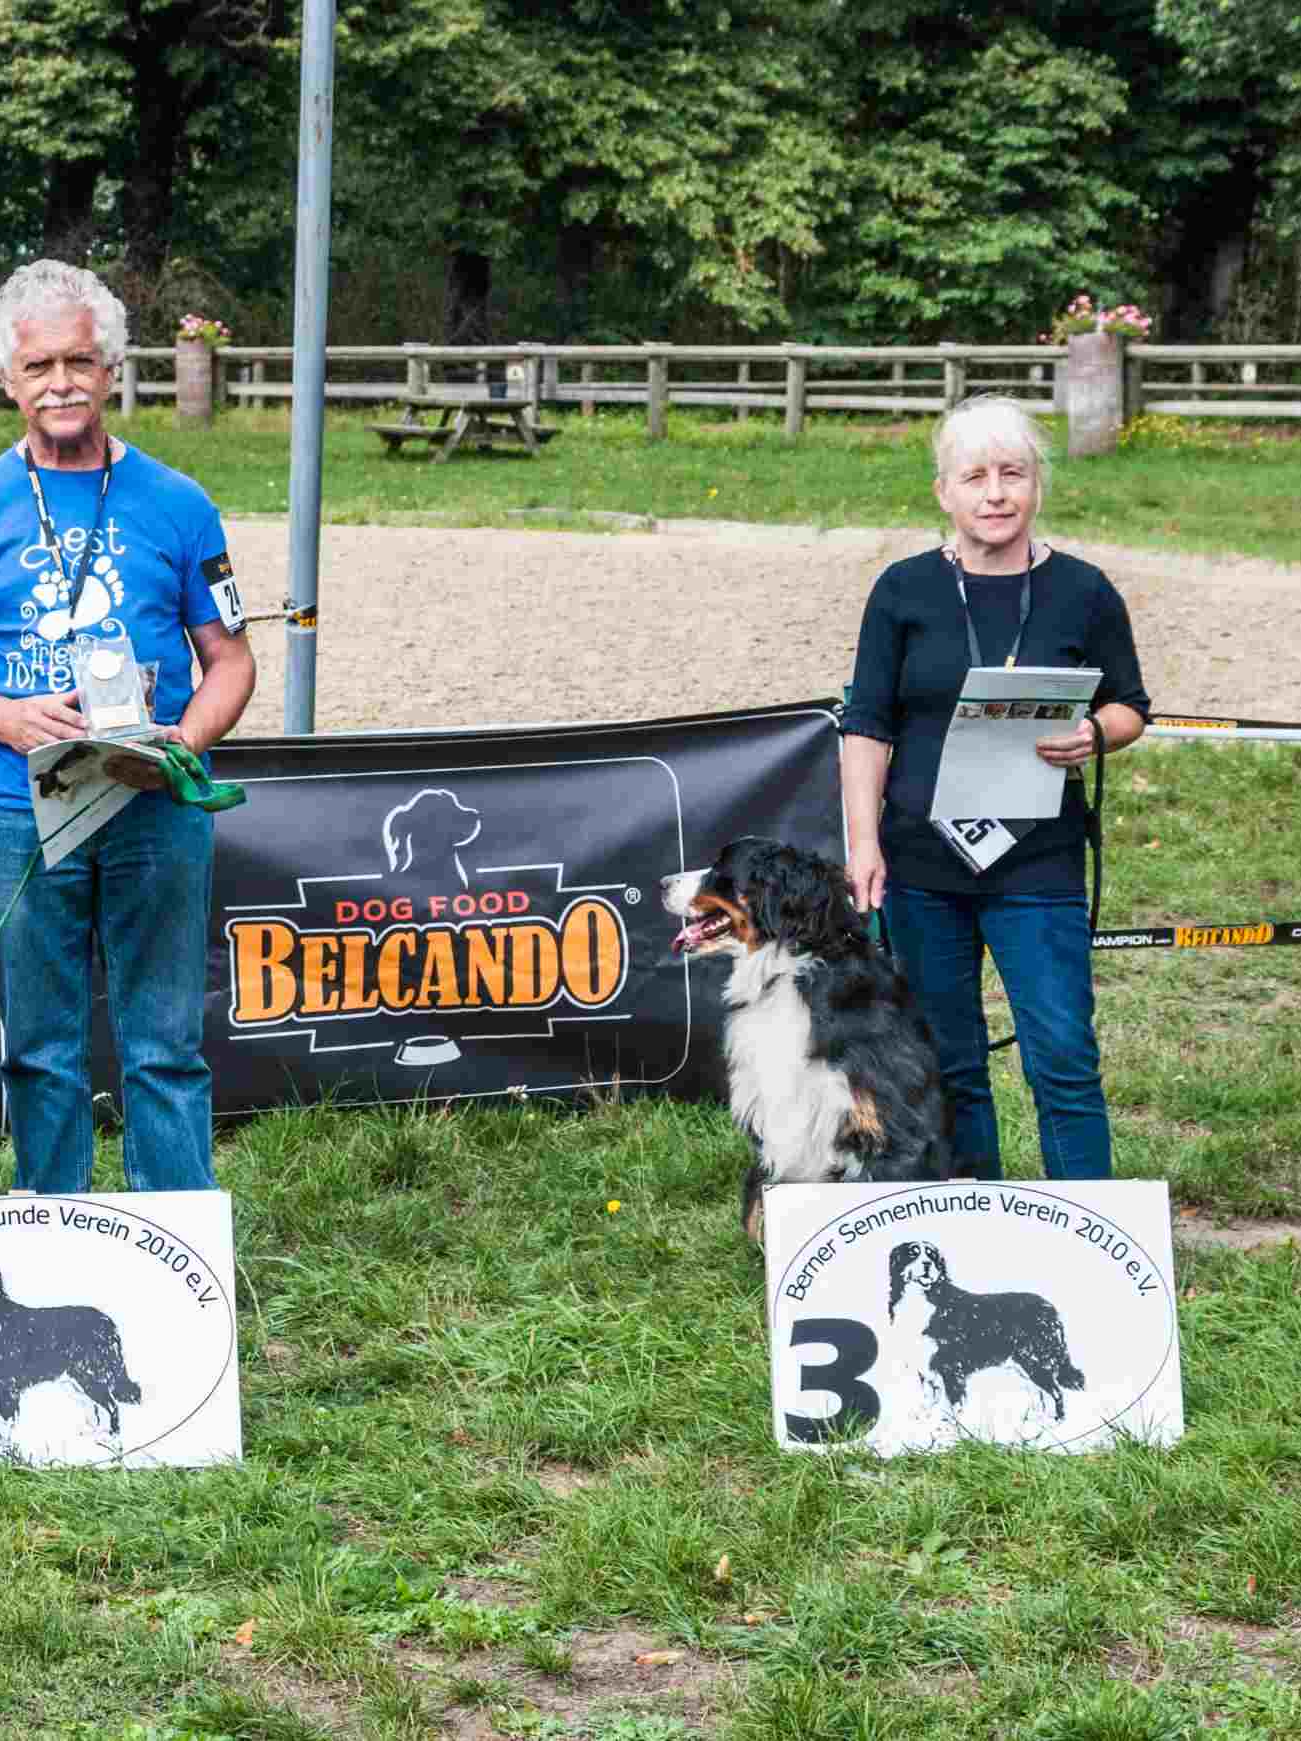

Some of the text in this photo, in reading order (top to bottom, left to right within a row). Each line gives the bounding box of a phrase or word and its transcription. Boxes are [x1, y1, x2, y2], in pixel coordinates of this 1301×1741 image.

[229, 898, 624, 1024] BELCANDO
[335, 891, 531, 924] DOG FOOD
[59, 1206, 130, 1242] Verein
[134, 1229, 189, 1274] 2010
[184, 1271, 219, 1309] e.V.
[786, 1191, 1159, 1302] Berner Sennenhunde Verein 2010 e.V.
[783, 1317, 882, 1445] 3
